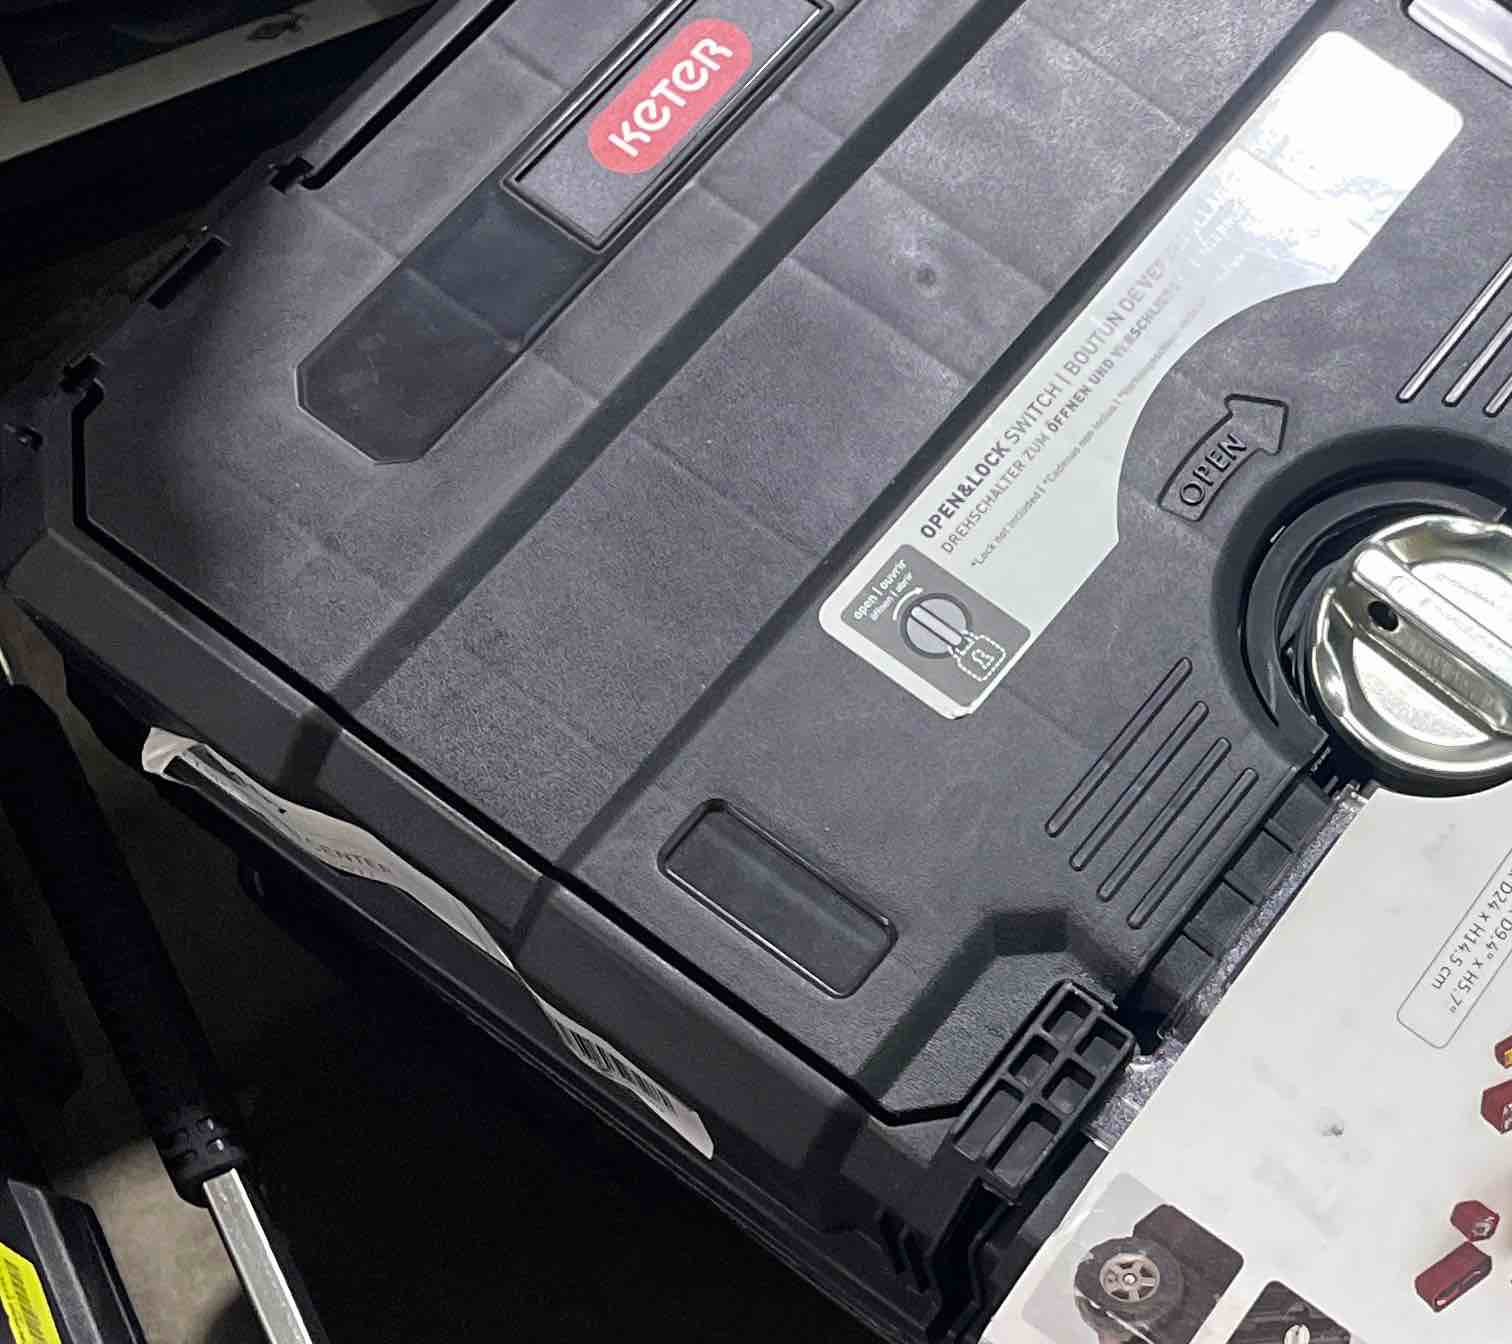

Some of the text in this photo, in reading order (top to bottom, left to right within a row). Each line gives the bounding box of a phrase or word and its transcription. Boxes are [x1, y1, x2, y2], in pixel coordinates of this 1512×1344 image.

[607, 36, 735, 159] KETER
[919, 439, 1010, 541] OPEN&LOCK
[1002, 380, 1063, 446] SWITCH
[940, 458, 1026, 555] DREHSCHALTER
[1022, 431, 1050, 461] ZUM
[1087, 356, 1115, 386] UND
[1164, 444, 1221, 506] OPEN
[1429, 964, 1454, 992] cm
[1447, 921, 1486, 967] H14.5
